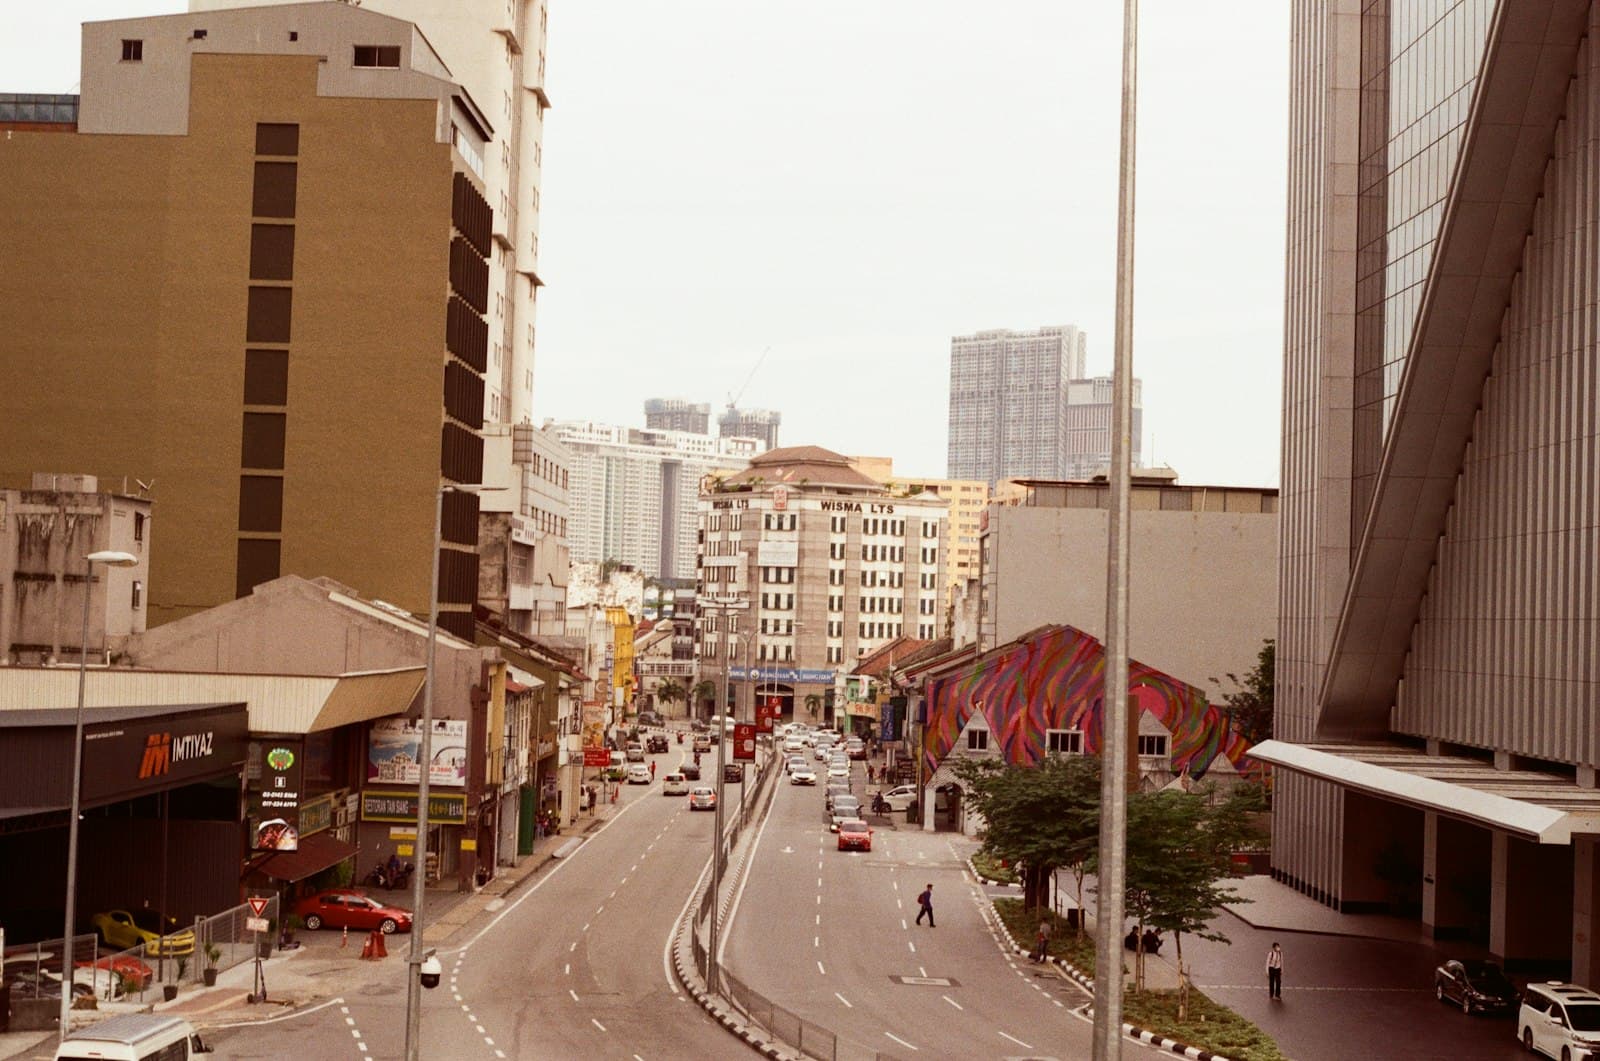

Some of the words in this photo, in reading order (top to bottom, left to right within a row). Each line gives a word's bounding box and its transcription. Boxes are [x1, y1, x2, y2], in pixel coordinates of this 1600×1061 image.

[713, 500, 733, 510] WISMA
[737, 499, 749, 509] LTS
[821, 501, 862, 513] WISMA
[871, 503, 894, 514] LTS
[172, 731, 214, 762] IMTIYAZ
